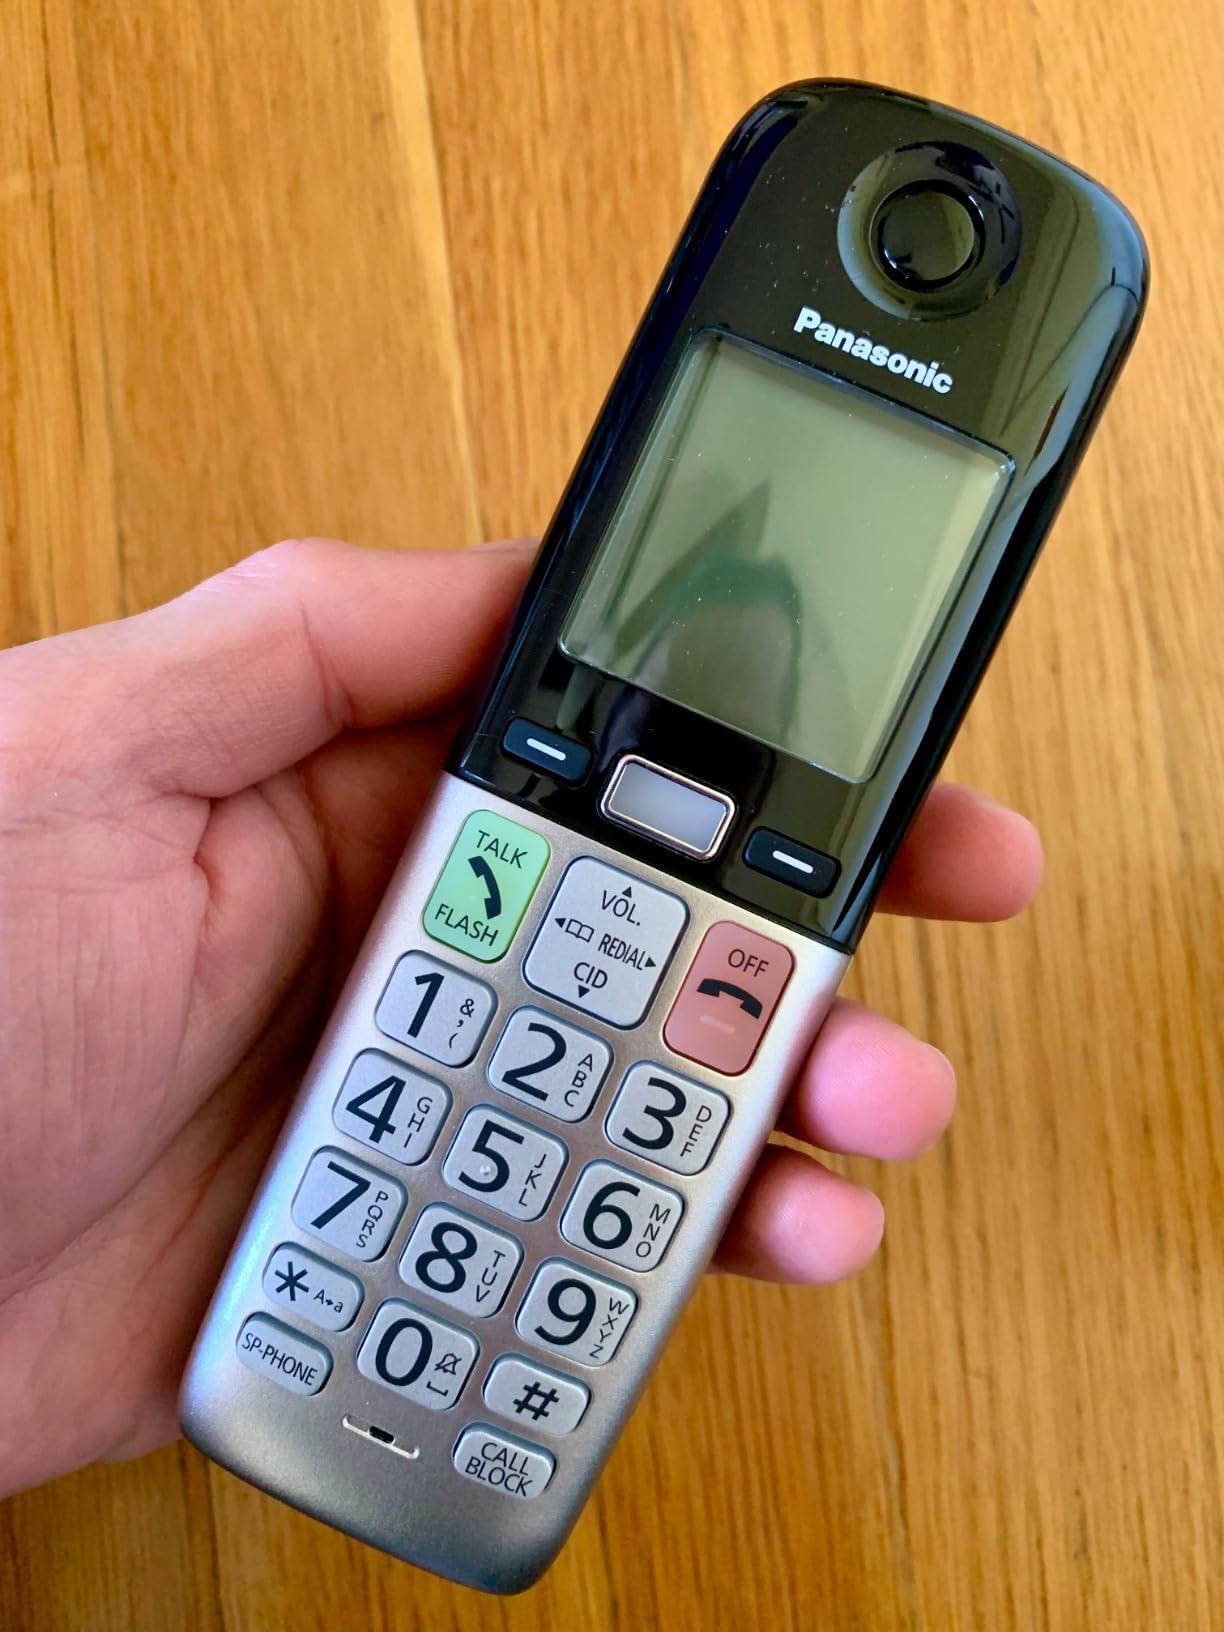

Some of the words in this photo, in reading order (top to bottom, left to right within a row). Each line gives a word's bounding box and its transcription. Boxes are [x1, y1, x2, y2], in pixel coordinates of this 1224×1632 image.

[793, 306, 953, 394] Panasonic
[476, 830, 528, 870] TALK
[435, 903, 499, 947] FLASH
[601, 890, 641, 926] VOL.
[573, 961, 608, 989] CID
[599, 933, 647, 972] REDIAL
[728, 948, 770, 978] OFF
[406, 972, 446, 1038] 1
[501, 1022, 567, 1102] 2
[346, 1075, 407, 1144] 4
[622, 1077, 688, 1151] 3
[458, 1119, 525, 1193] 5
[310, 1160, 371, 1230] 7
[582, 1181, 641, 1250] 6
[414, 1221, 478, 1293] 8
[534, 1278, 596, 1346] 9
[242, 1332, 319, 1387] SP-PHONE
[374, 1317, 434, 1387] 0
[512, 1381, 560, 1421] #
[464, 1456, 534, 1498] BLOCK
[480, 1441, 530, 1477] CALL
